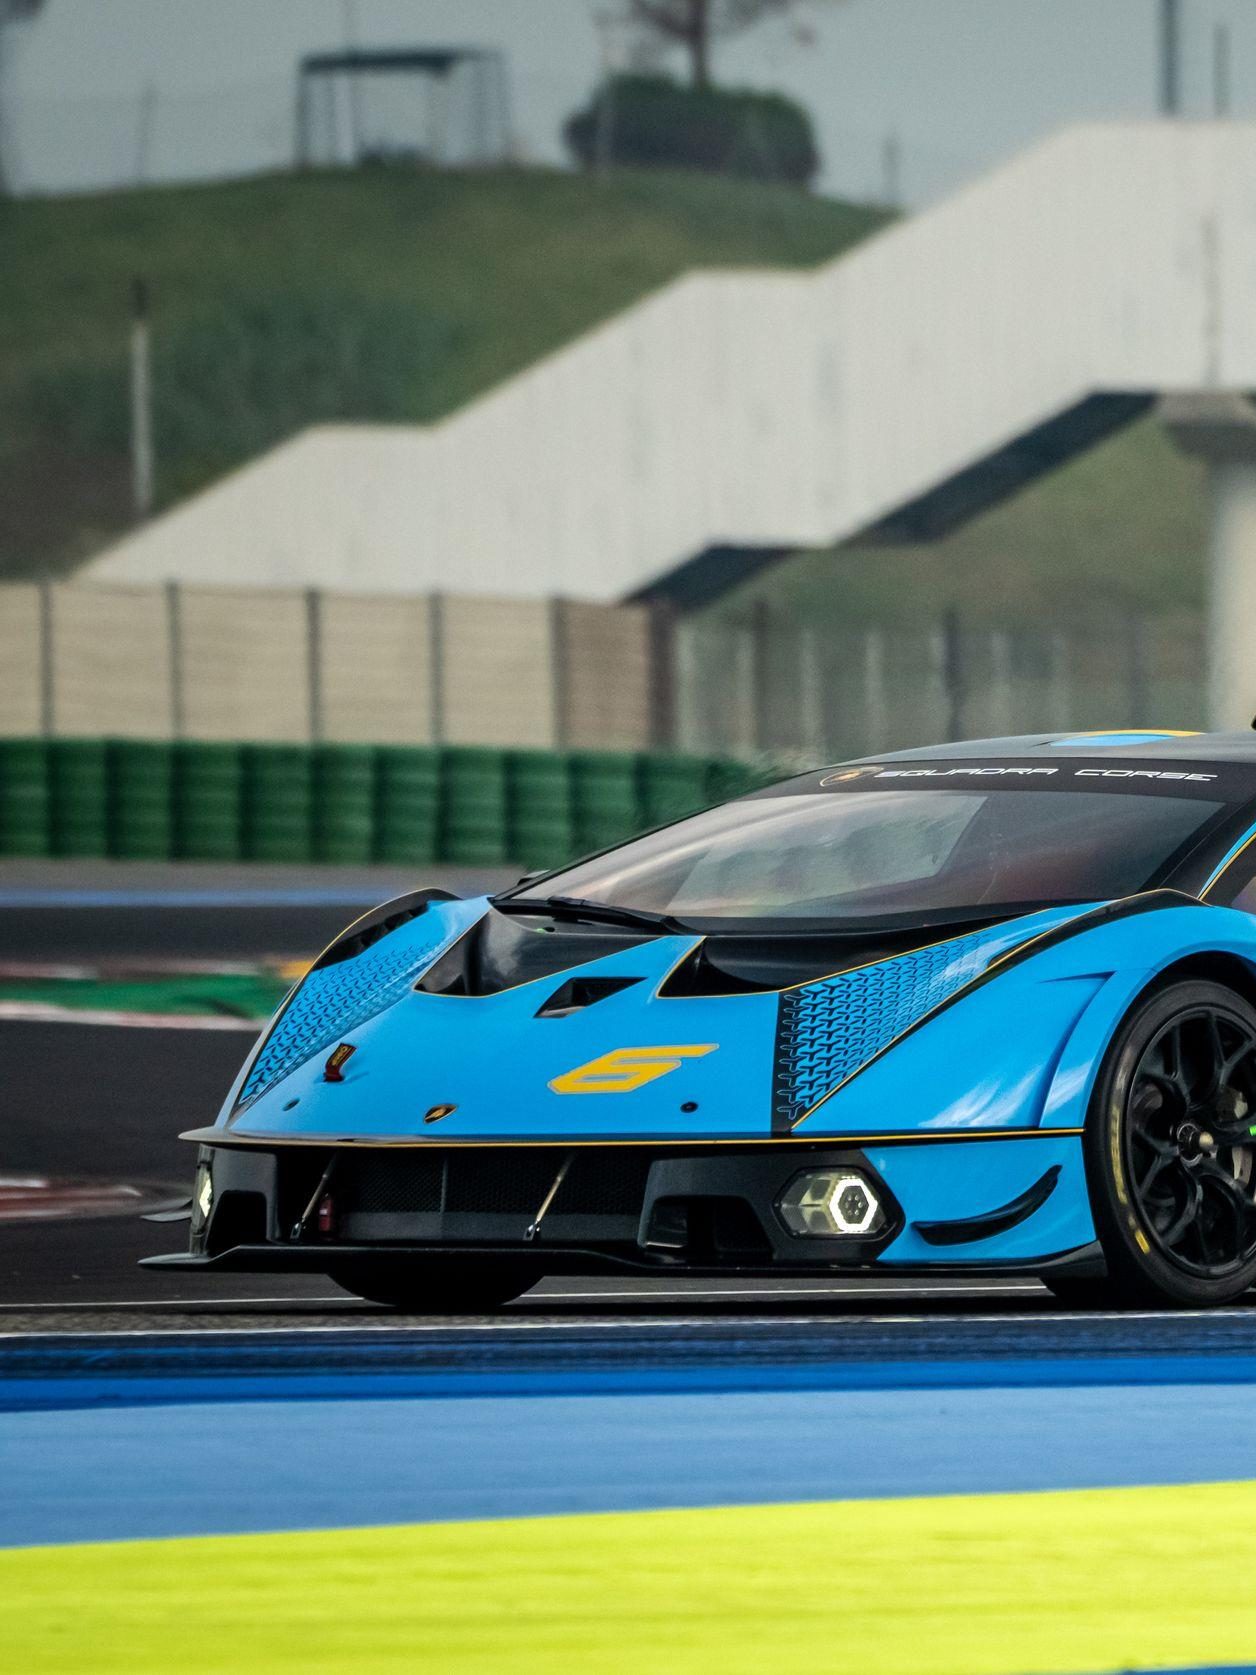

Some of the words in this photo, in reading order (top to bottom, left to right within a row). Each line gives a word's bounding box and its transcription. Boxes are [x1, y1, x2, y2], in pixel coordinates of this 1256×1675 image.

[874, 768, 1059, 778] SQUADRA
[1075, 769, 1218, 781] CORSE
[547, 1043, 720, 1095] 6
